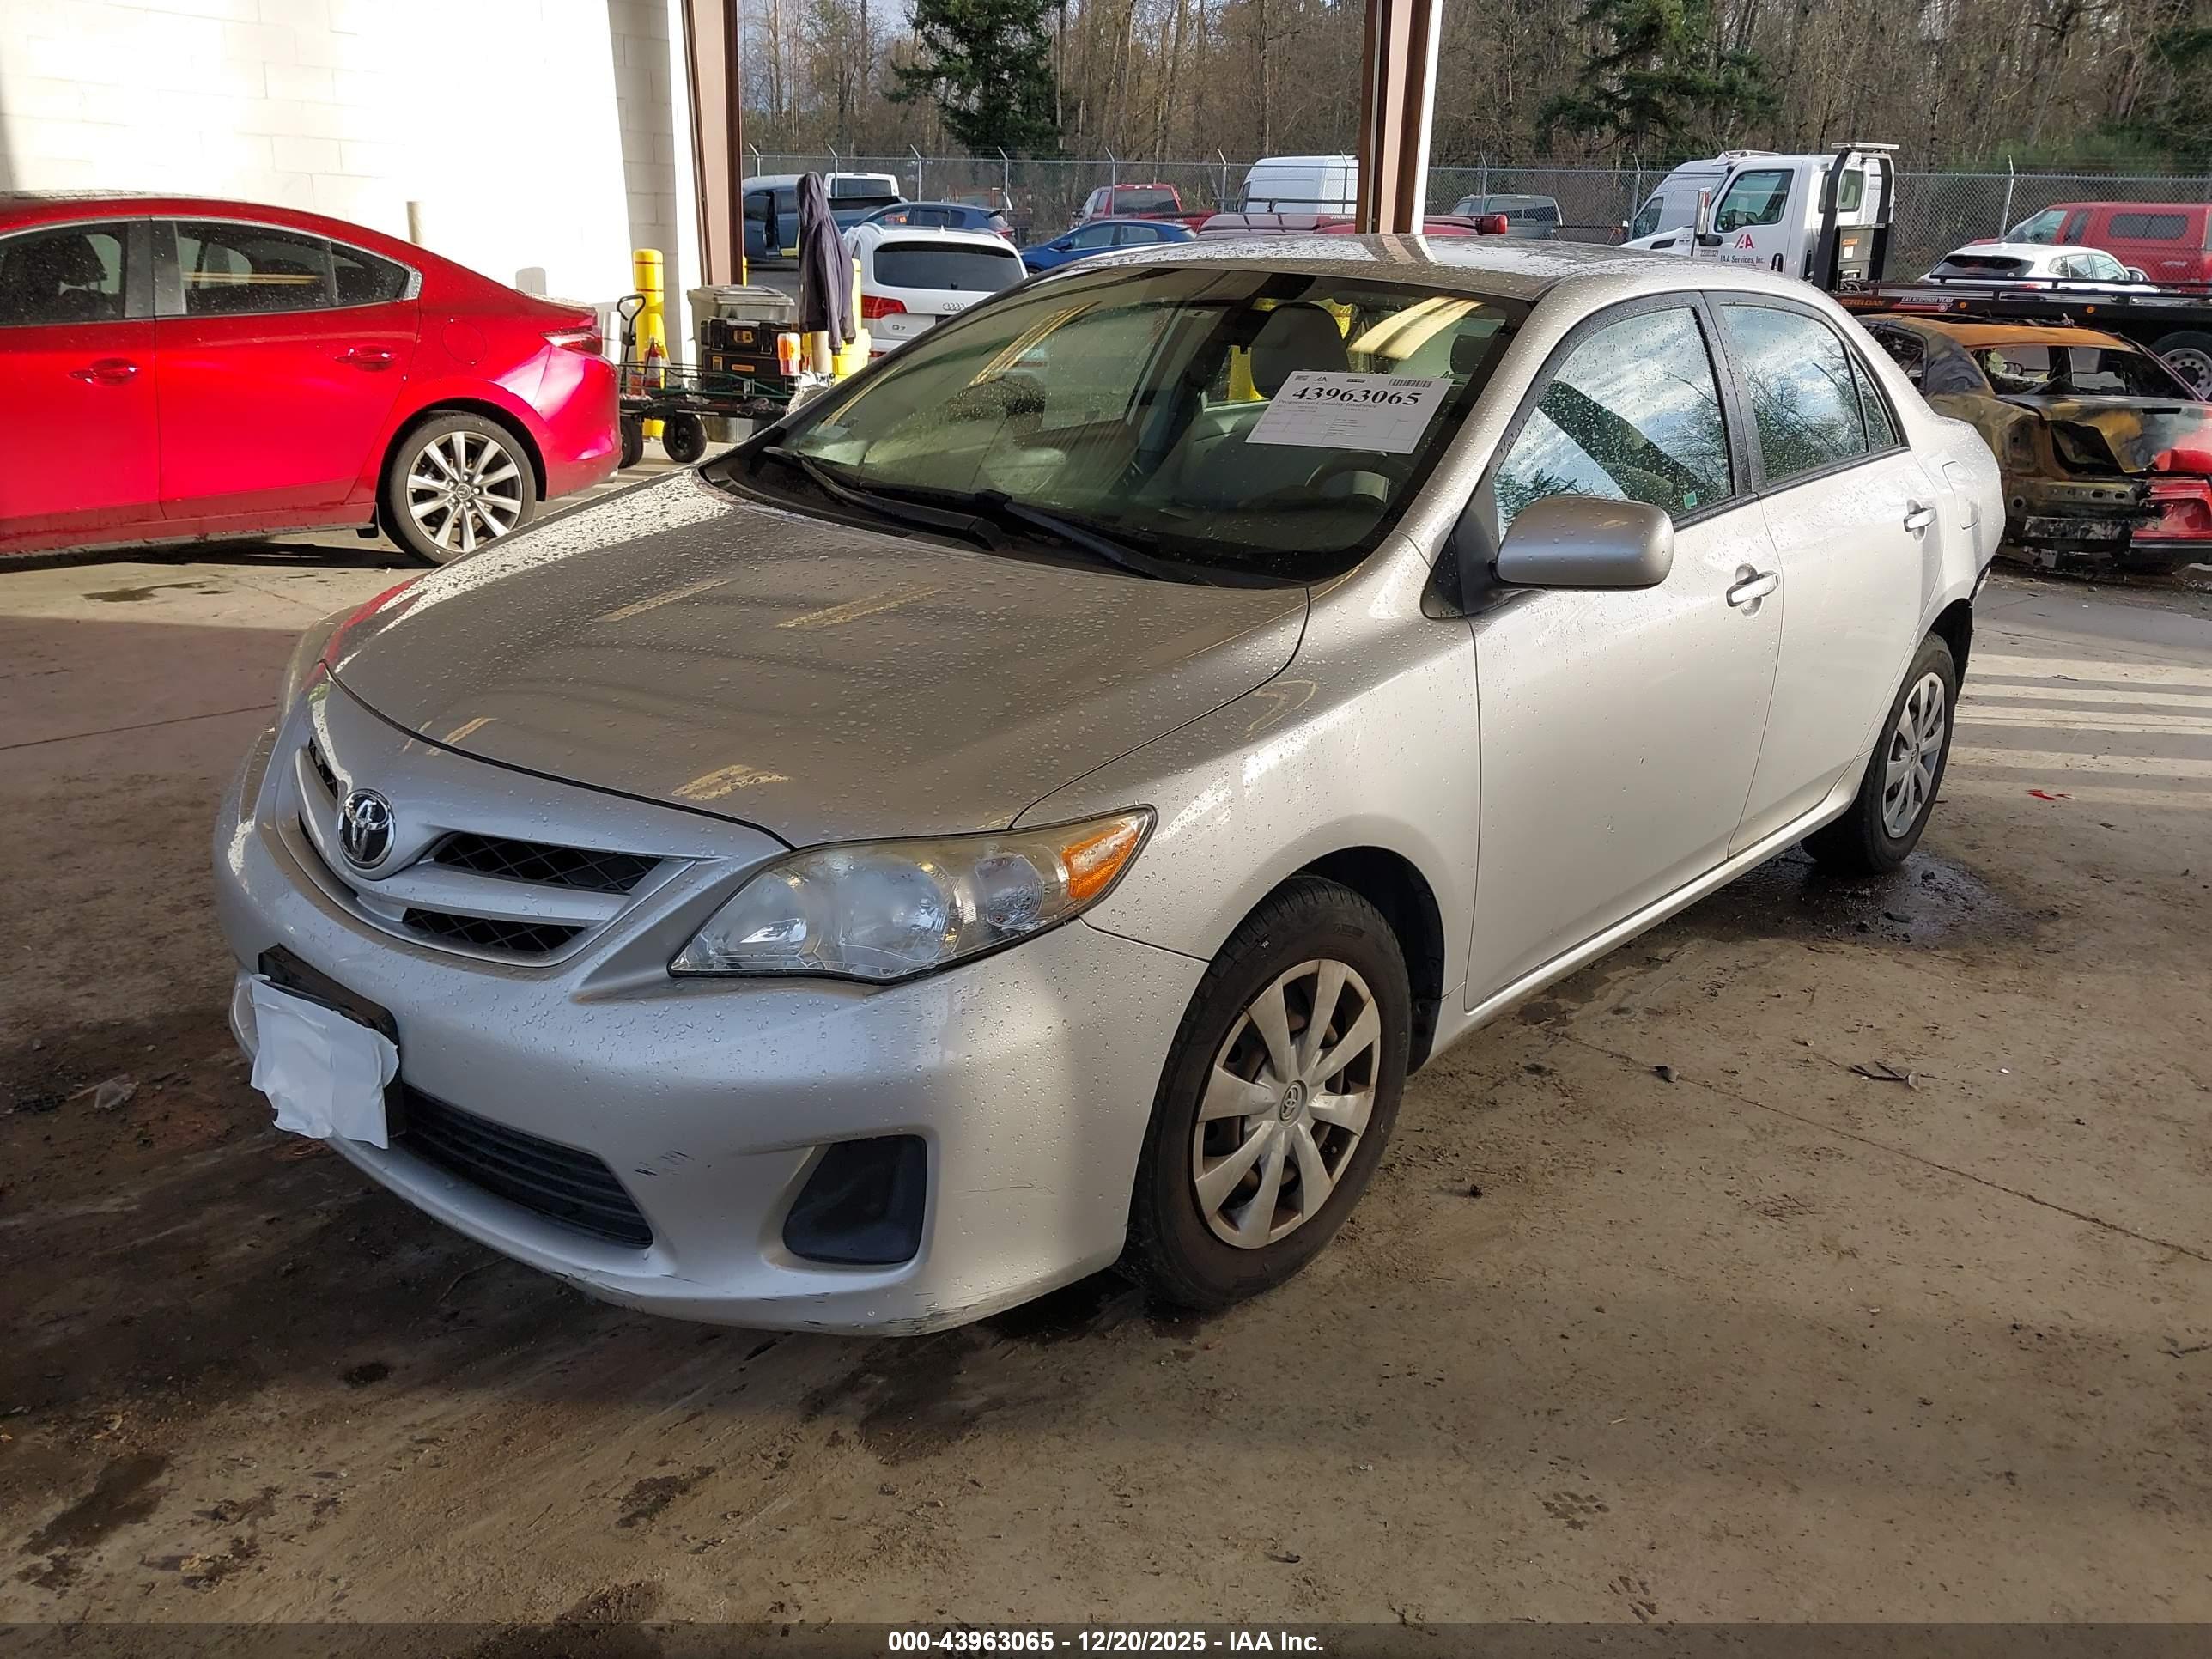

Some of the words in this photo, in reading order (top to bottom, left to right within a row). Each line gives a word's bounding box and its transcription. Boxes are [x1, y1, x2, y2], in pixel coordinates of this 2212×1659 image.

[1720, 254, 1730, 263] IAA
[1731, 255, 1753, 264] Services,
[1291, 386, 1423, 406] 43963065
